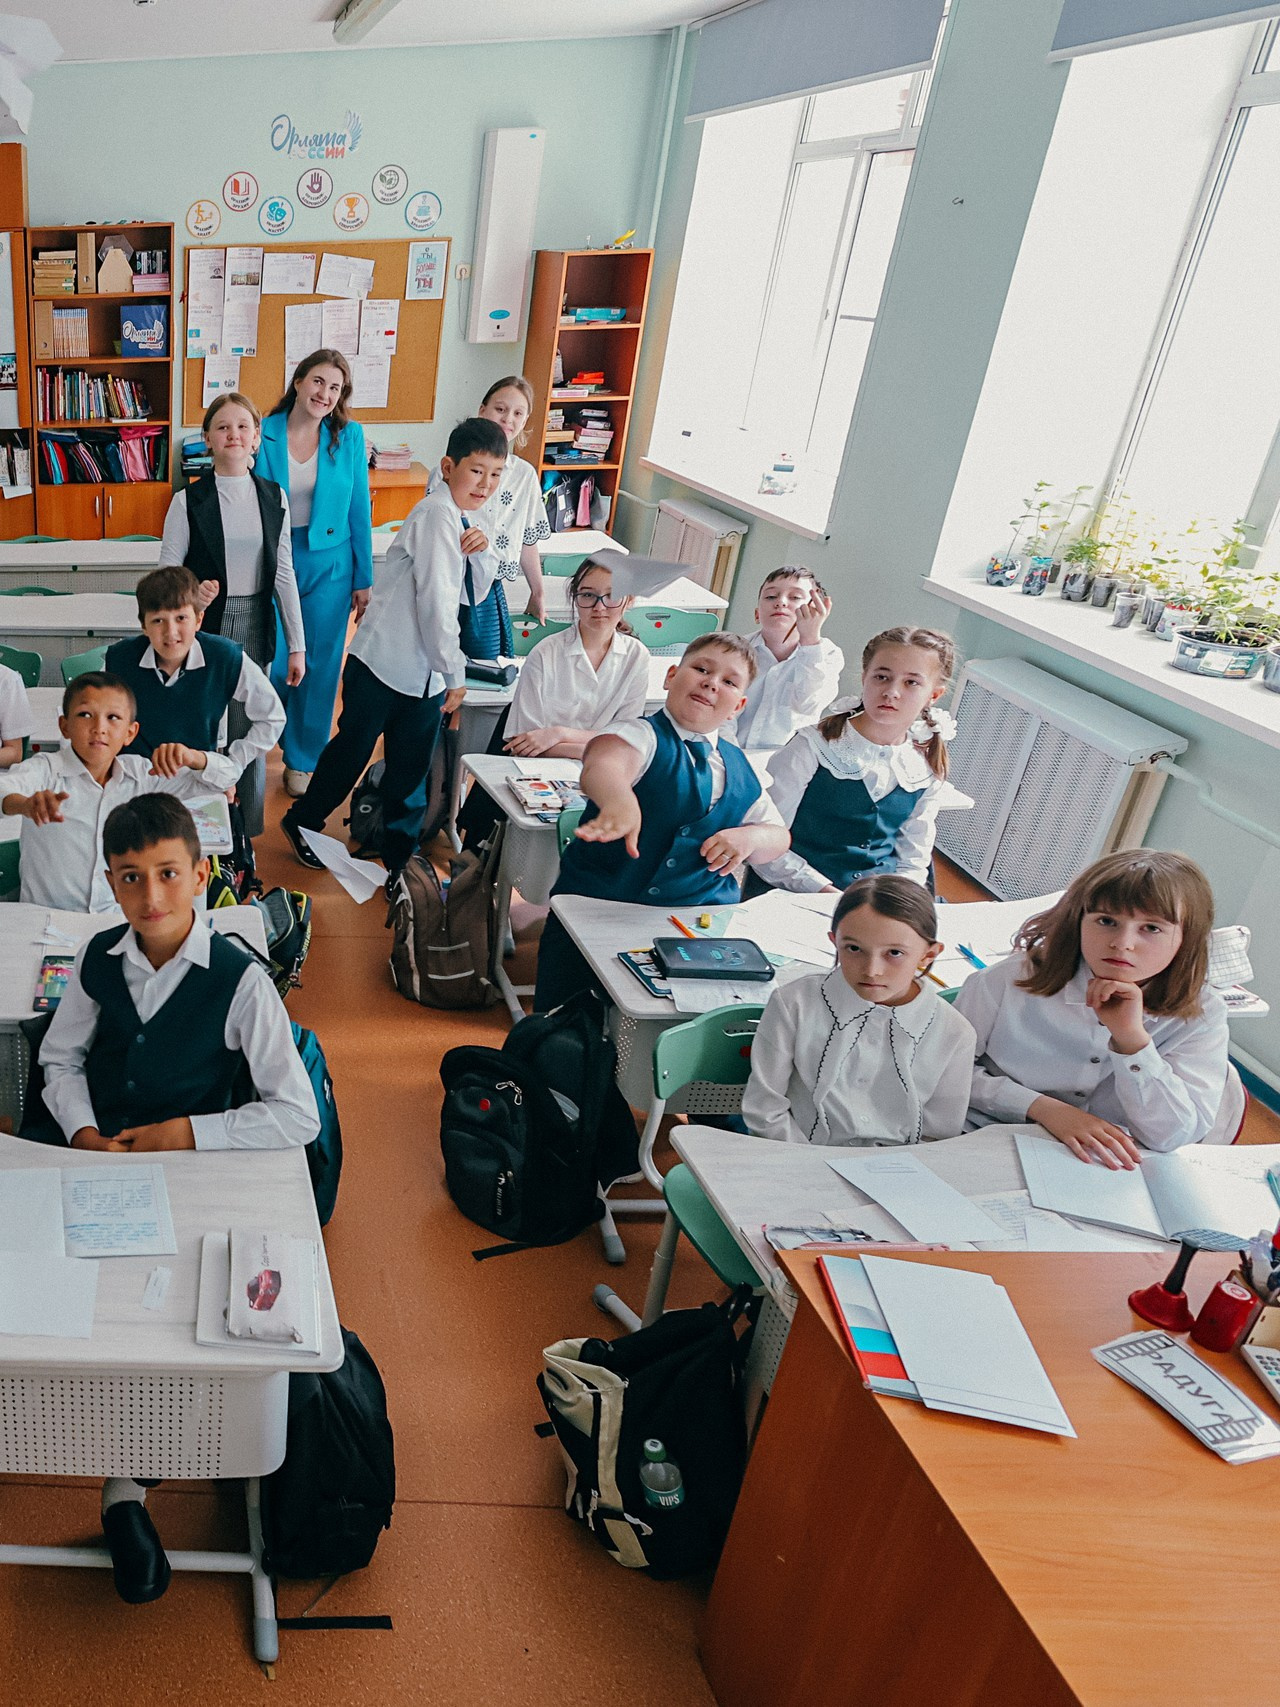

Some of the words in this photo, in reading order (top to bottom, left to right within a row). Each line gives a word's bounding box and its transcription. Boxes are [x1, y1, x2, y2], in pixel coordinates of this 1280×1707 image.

[271, 114, 347, 154] Орлята
[1140, 1351, 1235, 1427] РАДУГА
[659, 1493, 681, 1507] VIPS
